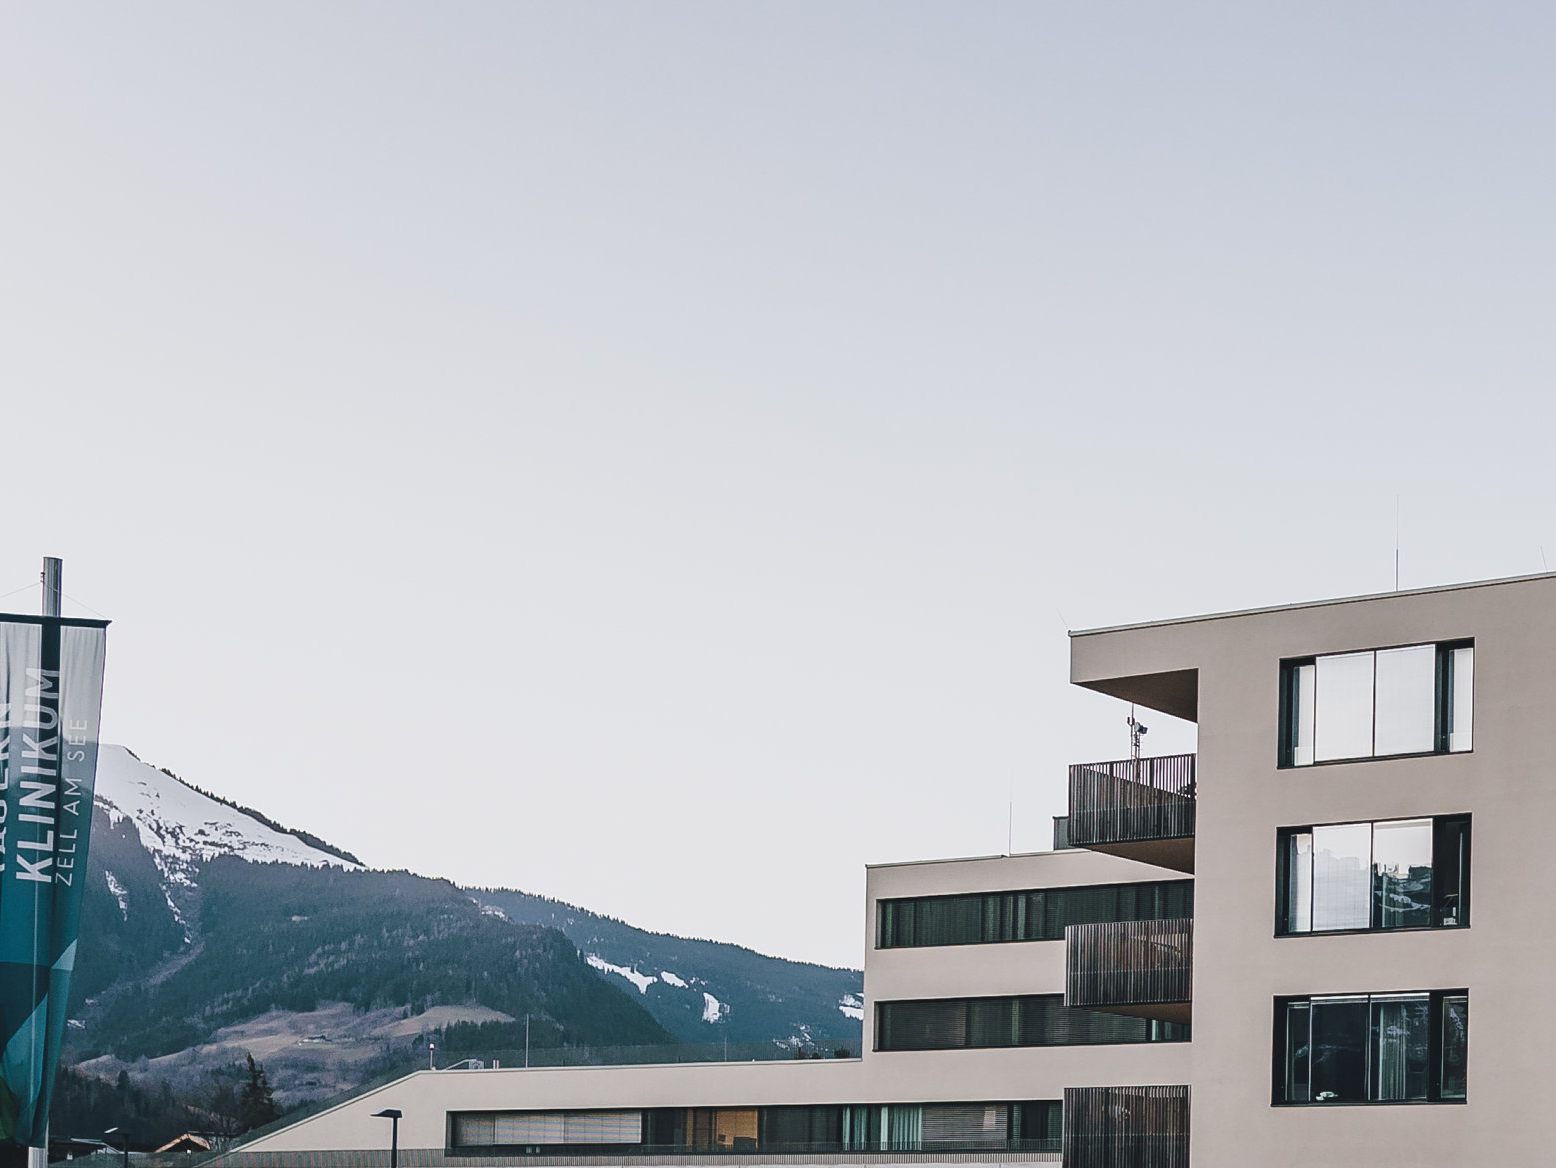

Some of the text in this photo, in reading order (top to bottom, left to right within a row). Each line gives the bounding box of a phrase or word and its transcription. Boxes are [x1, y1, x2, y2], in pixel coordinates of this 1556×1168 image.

[15, 667, 60, 884] KLINIKUM
[55, 718, 89, 887] ZELL AM SEE
